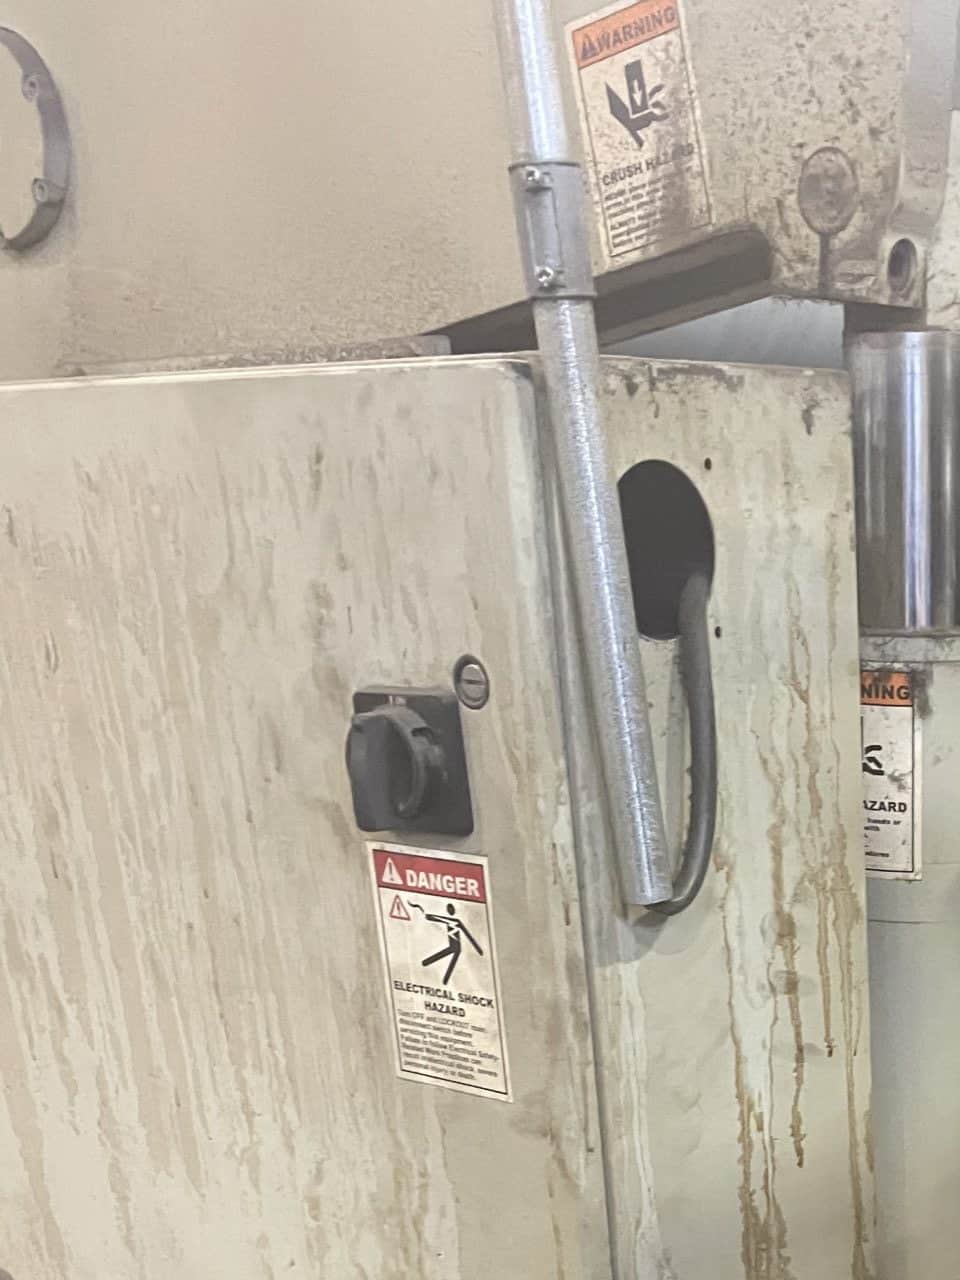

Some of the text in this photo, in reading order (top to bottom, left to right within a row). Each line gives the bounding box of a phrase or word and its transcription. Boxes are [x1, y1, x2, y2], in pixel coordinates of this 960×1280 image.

[597, 7, 675, 50] WARNING
[603, 162, 643, 185] CRUSH
[861, 684, 911, 700] NING
[863, 800, 907, 812] ZARD
[406, 869, 480, 897] DANGER
[394, 980, 494, 1008] ELECTRICAL SHOCK
[424, 1001, 465, 1017] HAZARD
